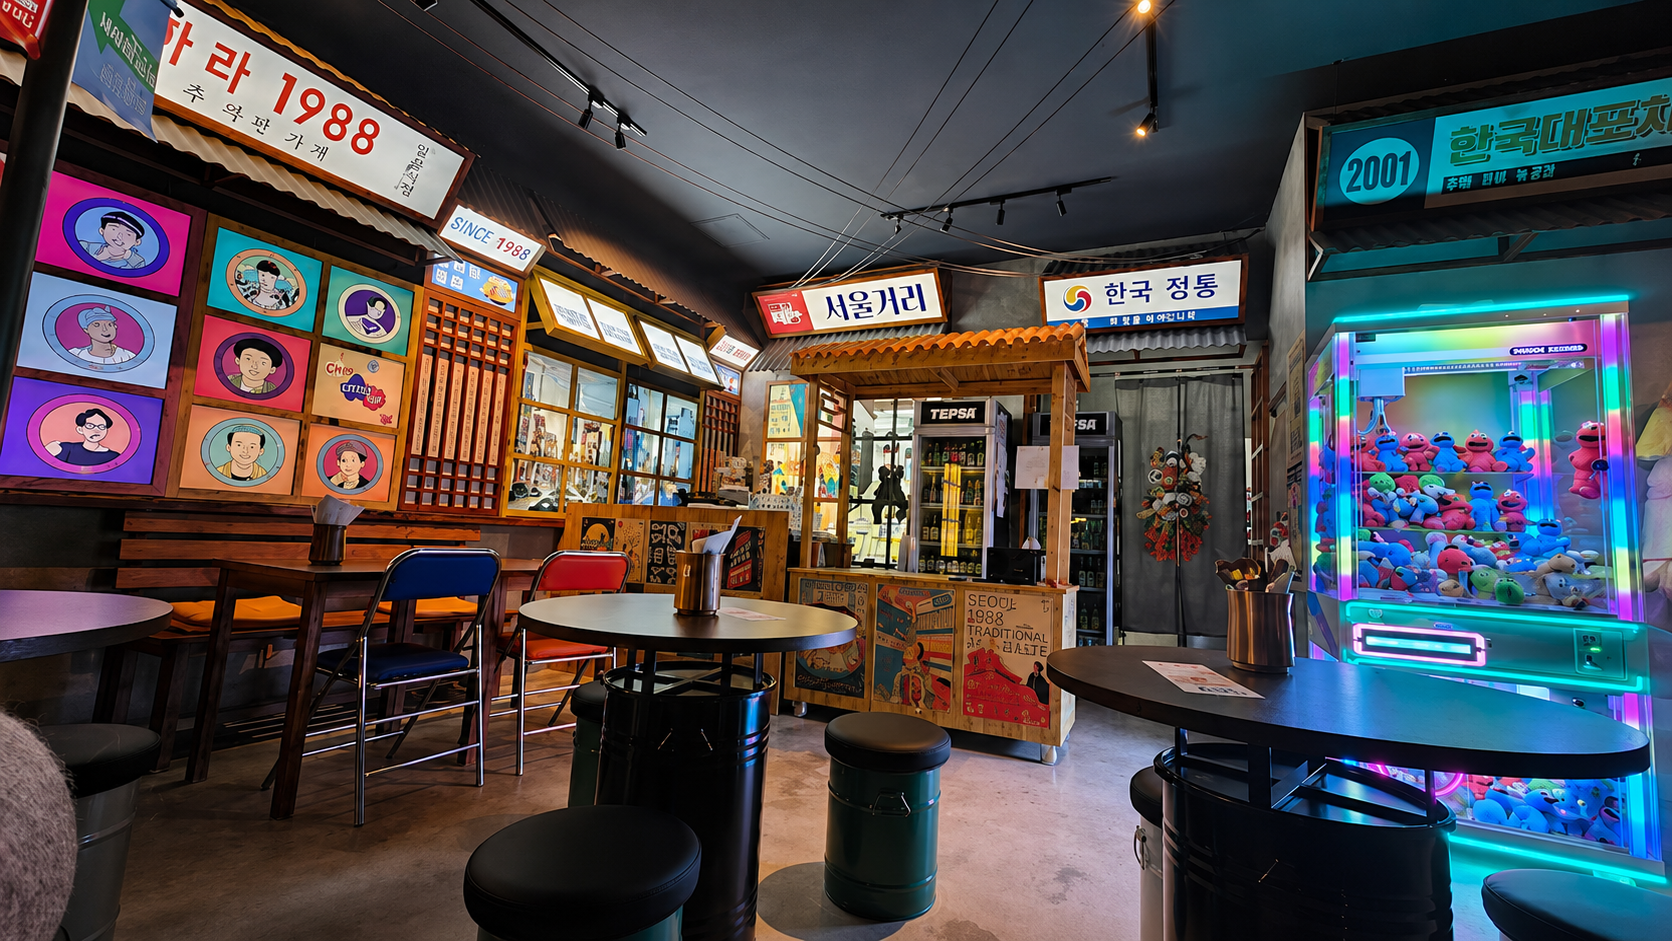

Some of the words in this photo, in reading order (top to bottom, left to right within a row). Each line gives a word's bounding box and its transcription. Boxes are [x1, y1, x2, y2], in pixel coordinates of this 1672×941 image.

[273, 72, 381, 156] 1988
[1346, 150, 1411, 193] 2001
[450, 216, 495, 244] SINCE
[496, 237, 532, 261] 1988
[825, 283, 927, 321] 서울거리
[1104, 280, 1153, 306] 한국
[1166, 273, 1219, 301] 정통
[930, 407, 977, 420] TEPSA
[967, 608, 1004, 627] 1988
[968, 593, 1016, 611] SEOUL
[967, 624, 1049, 644] TRADITIONAL
